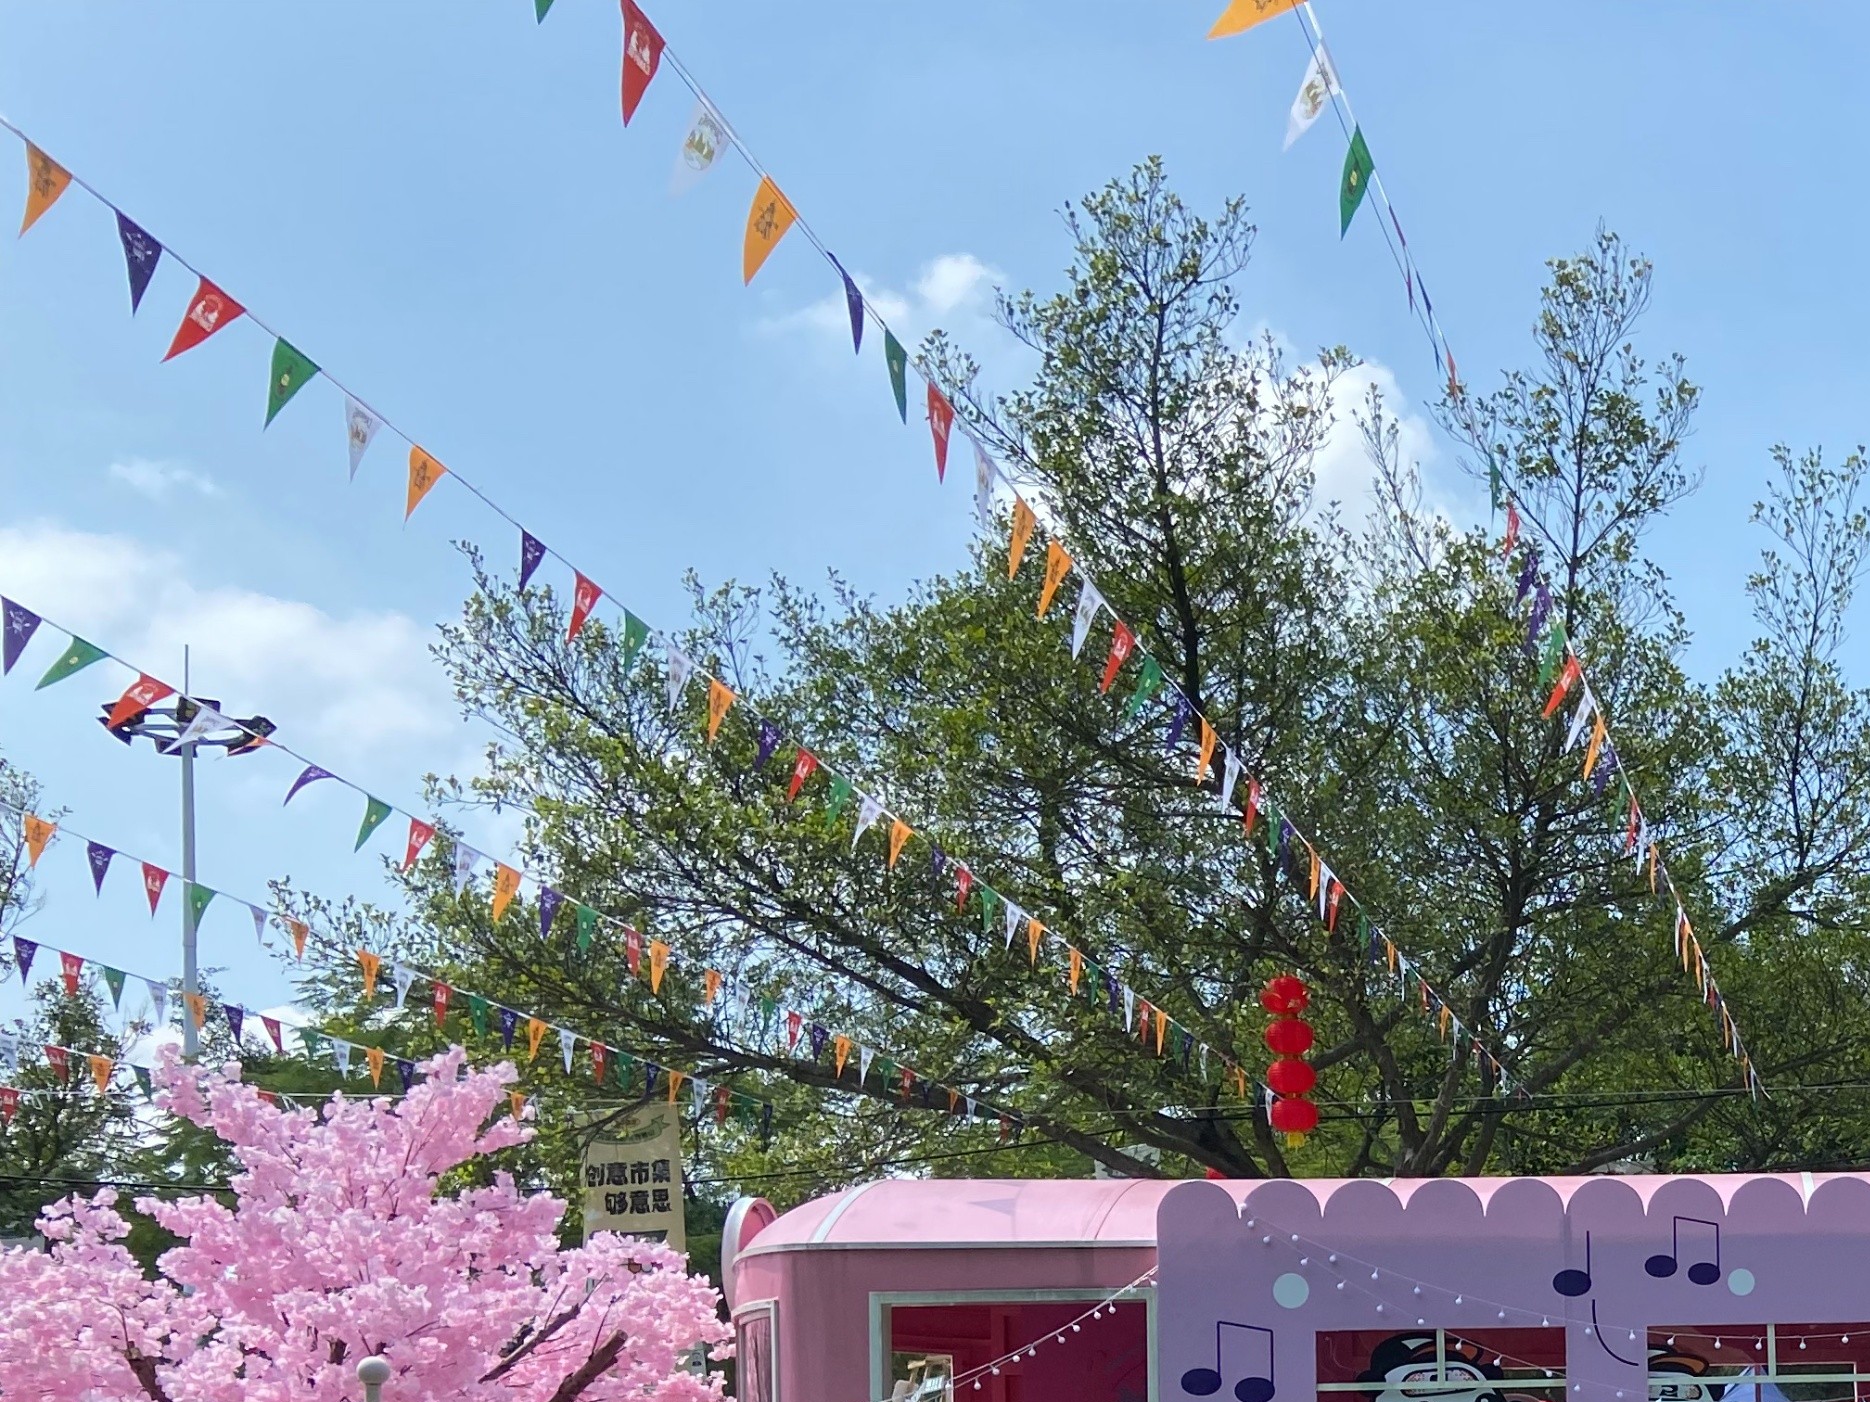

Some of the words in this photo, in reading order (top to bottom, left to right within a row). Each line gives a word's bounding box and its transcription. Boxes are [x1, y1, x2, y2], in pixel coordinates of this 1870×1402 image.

[586, 1159, 671, 1188] 创意市集
[605, 1188, 672, 1215] 够意思
